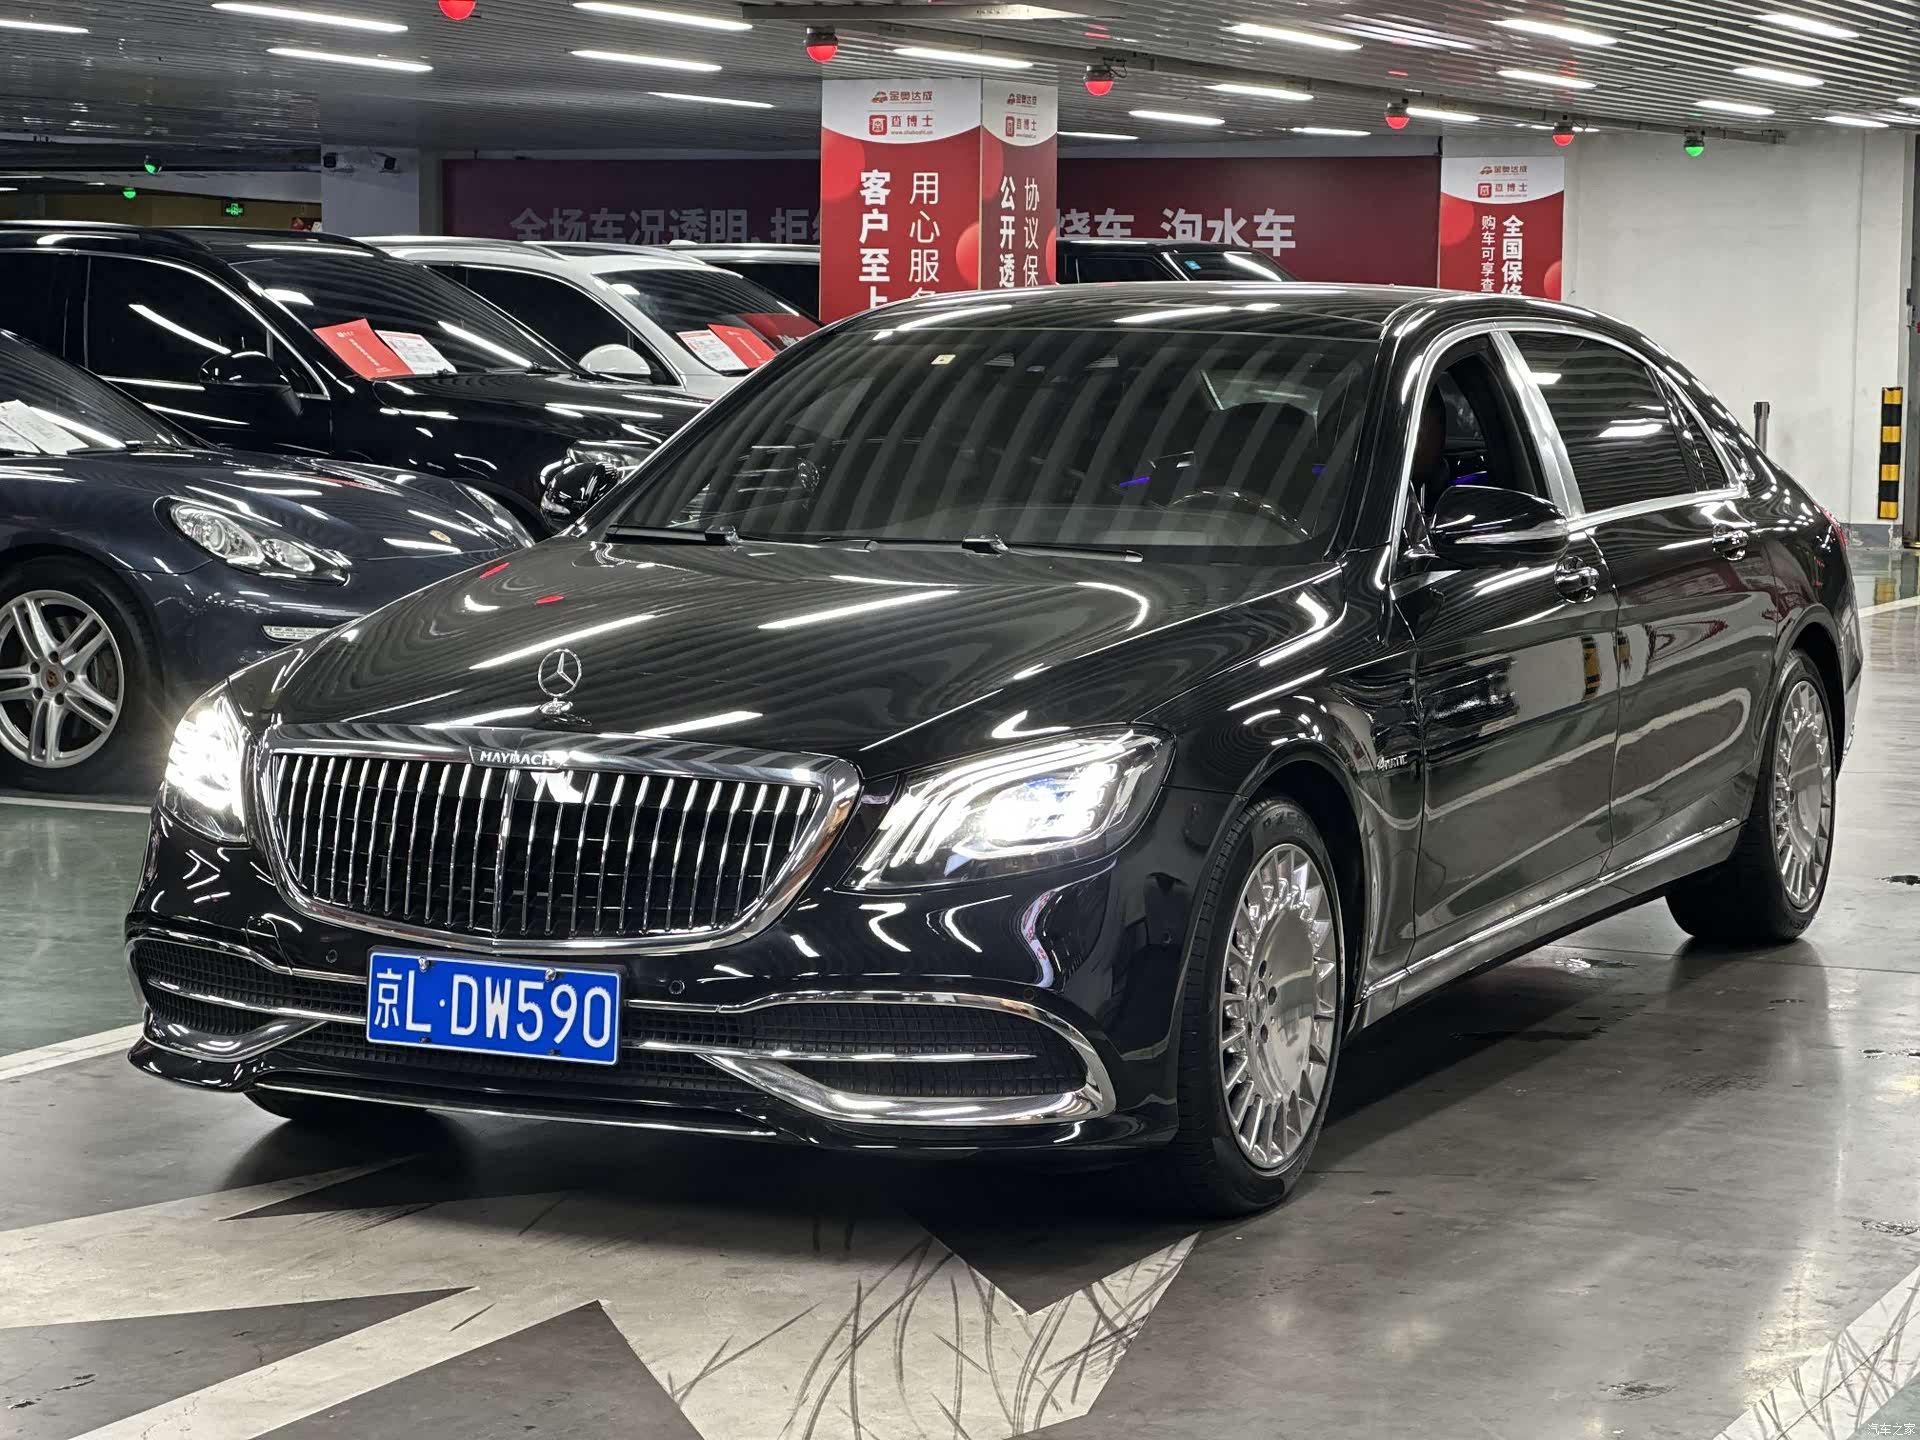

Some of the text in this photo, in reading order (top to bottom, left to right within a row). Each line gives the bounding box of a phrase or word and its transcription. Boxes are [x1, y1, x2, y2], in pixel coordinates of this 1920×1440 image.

[859, 169, 892, 309] 客户至上
[1480, 215, 1496, 293] 购车可享查
[480, 750, 553, 767] MAYBACH
